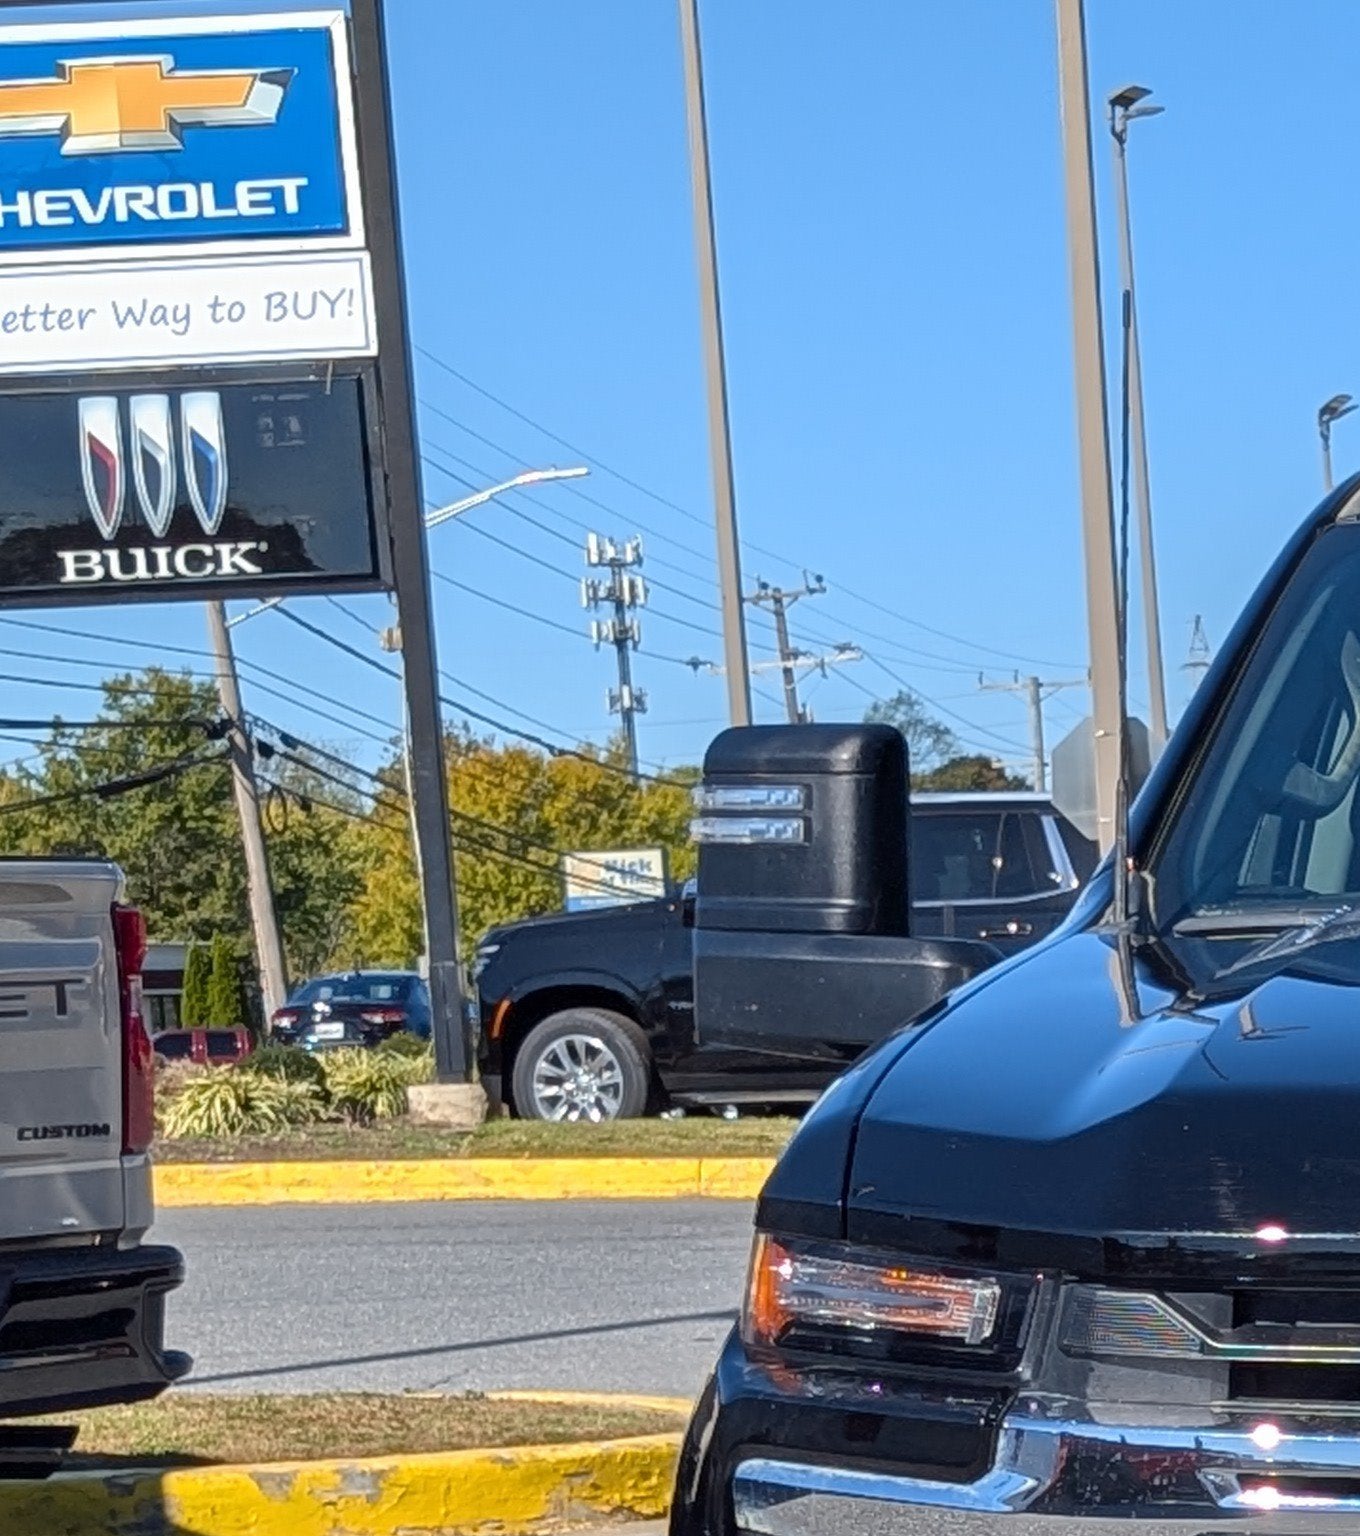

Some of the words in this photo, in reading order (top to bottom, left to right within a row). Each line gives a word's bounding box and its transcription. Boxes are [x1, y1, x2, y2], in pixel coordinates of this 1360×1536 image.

[112, 298, 191, 336] Way
[208, 294, 246, 324] to
[264, 288, 355, 322] BUY!
[57, 541, 264, 583] BUICK
[17, 1123, 111, 1141] CUSTOM
